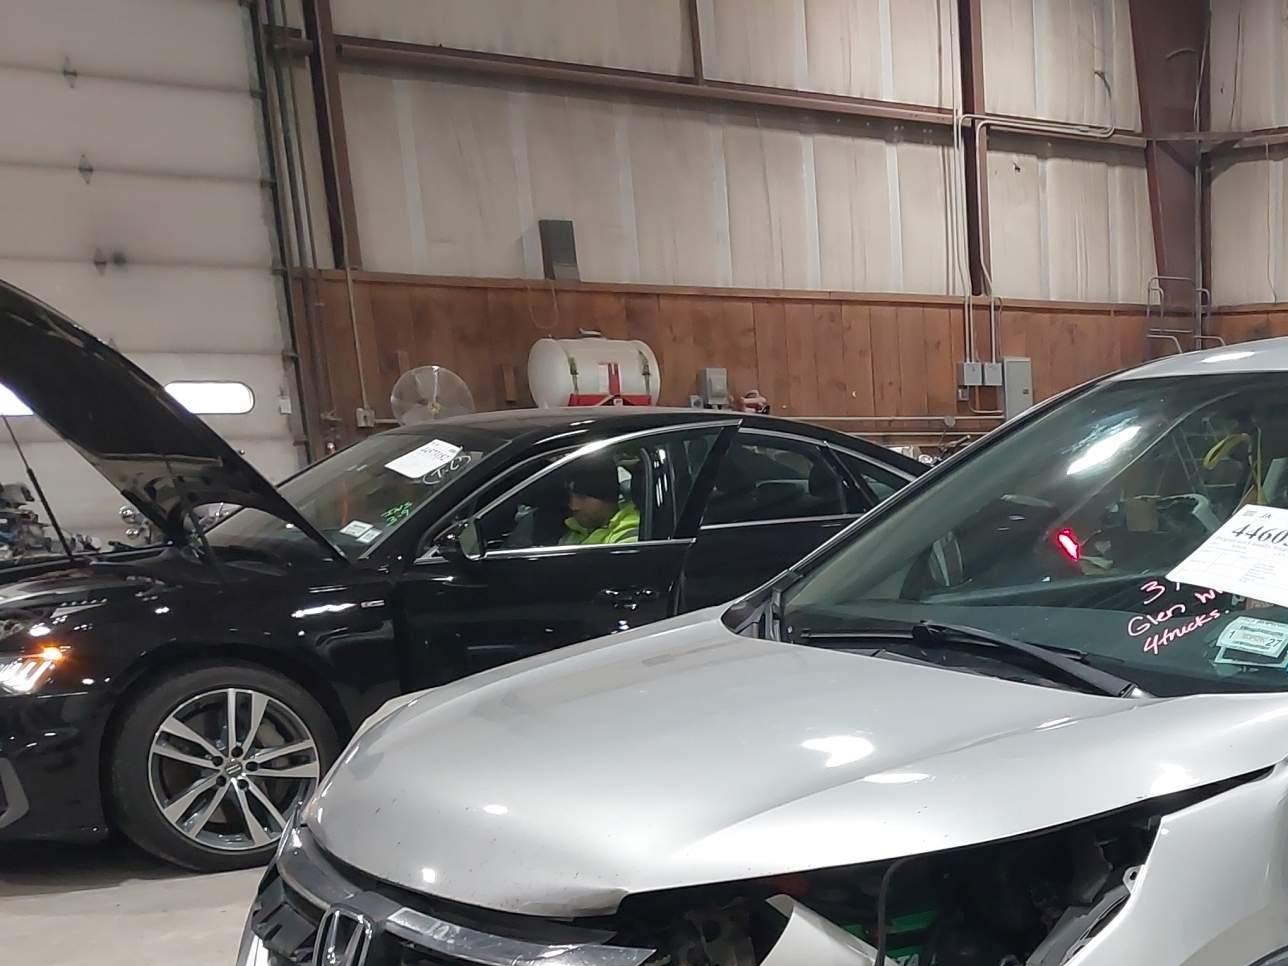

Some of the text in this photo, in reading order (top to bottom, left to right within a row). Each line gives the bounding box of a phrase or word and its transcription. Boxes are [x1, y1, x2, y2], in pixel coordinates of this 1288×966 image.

[1140, 581, 1165, 605] 3
[1128, 604, 1186, 636] Glen
[1265, 637, 1283, 648] 27
